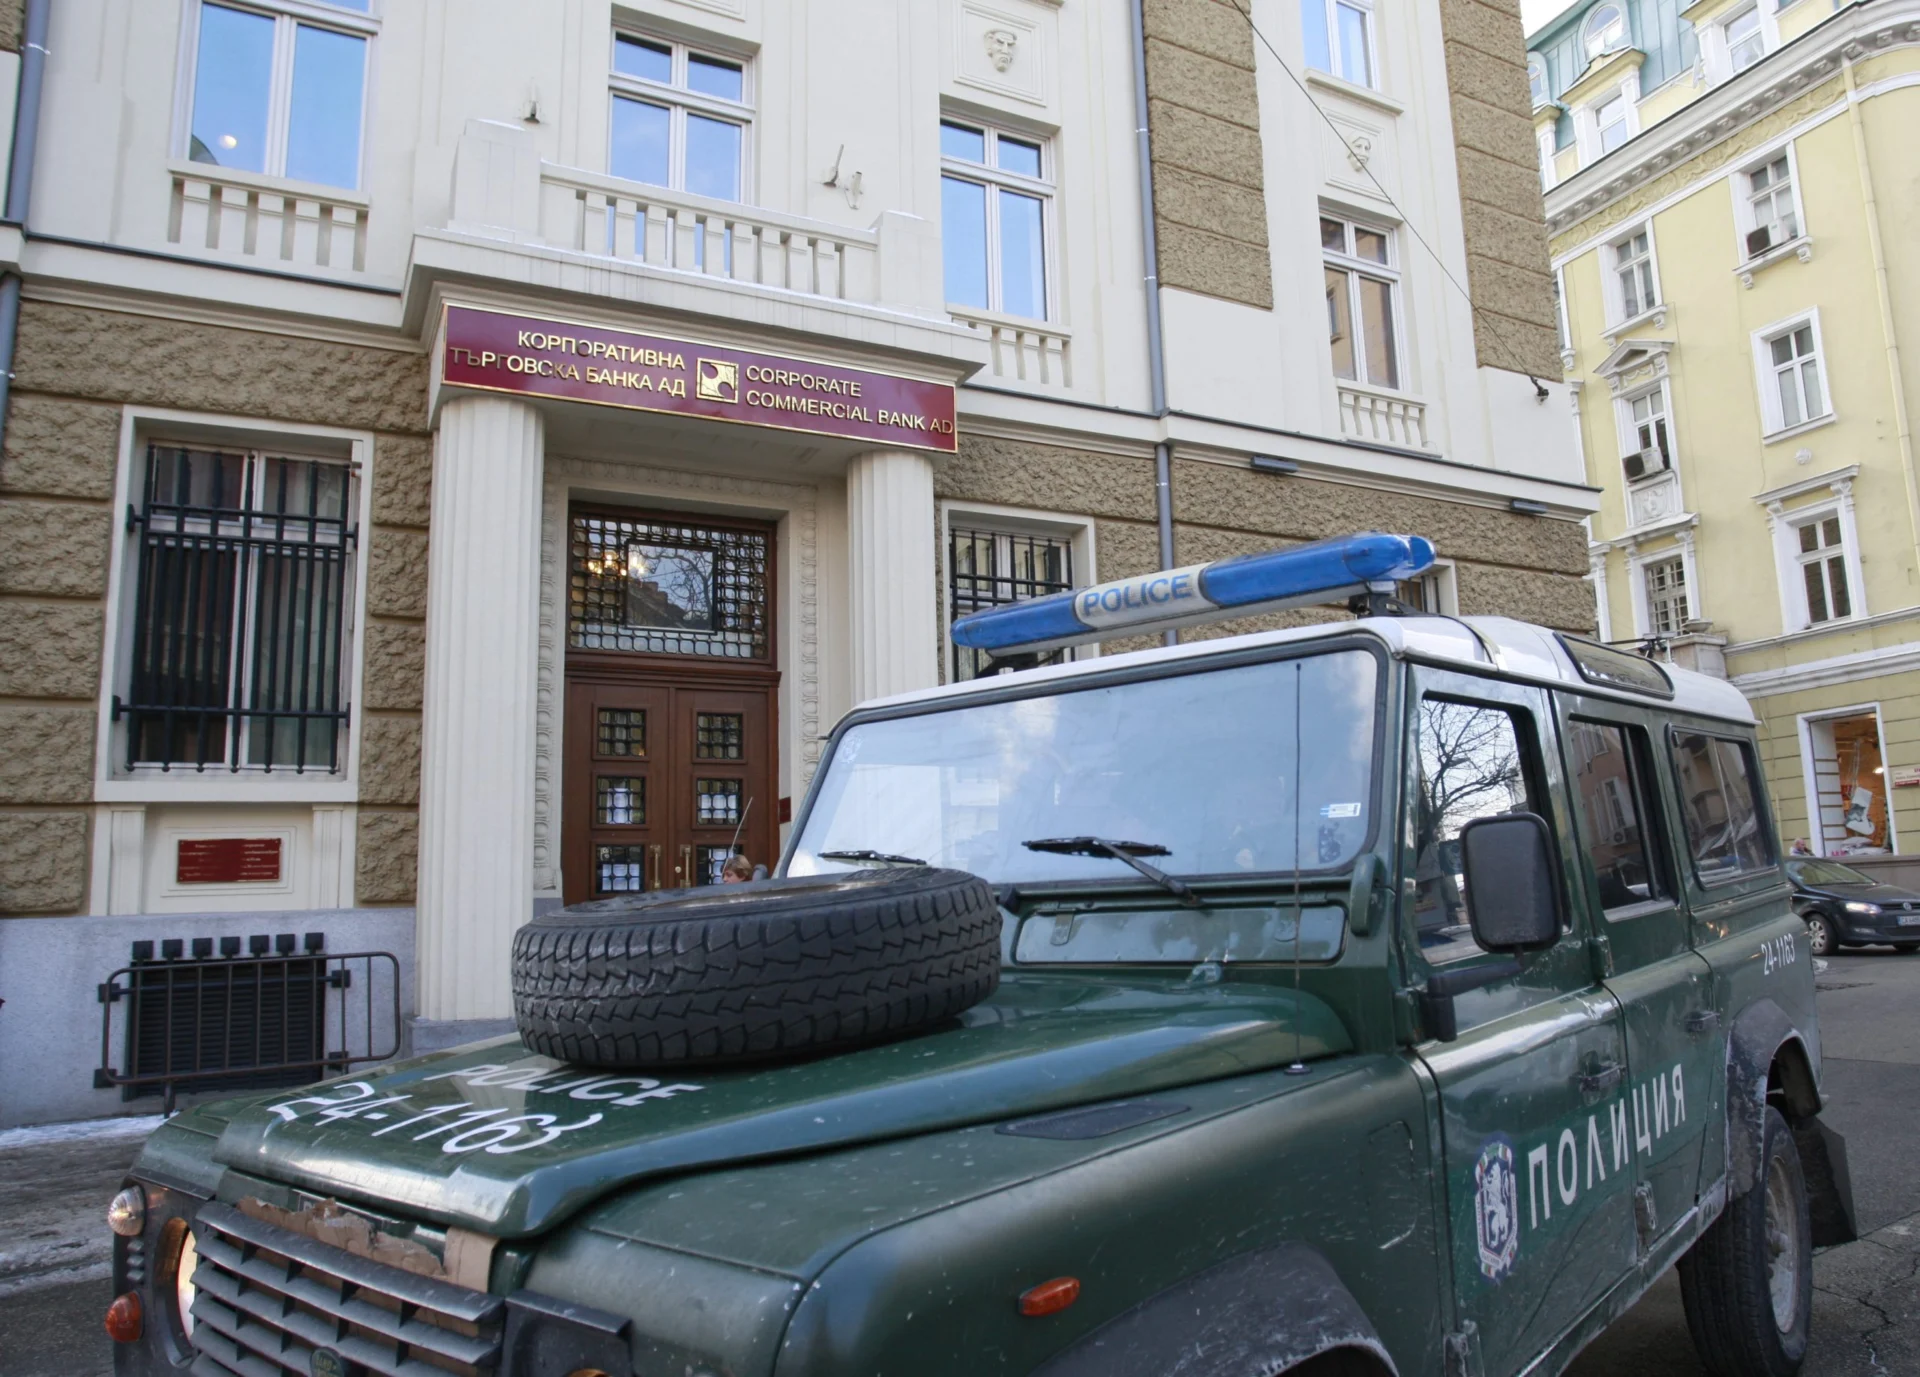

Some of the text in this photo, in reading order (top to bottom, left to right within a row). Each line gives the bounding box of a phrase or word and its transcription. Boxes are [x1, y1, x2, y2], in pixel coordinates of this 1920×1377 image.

[518, 330, 686, 370] КОРПОРАТИВНА
[450, 346, 686, 399] ТЪРГОВСКА БАНКА АД
[746, 365, 861, 397] CORPORATE
[746, 390, 953, 435] COMMERCIAL BANK AD
[1082, 573, 1194, 617] POLICE
[1761, 932, 1796, 976] 24-1163
[423, 1064, 706, 1107] POLICE
[266, 1081, 604, 1155] 24-1163
[1528, 1063, 1686, 1230] ПОЛИЦИЯ
